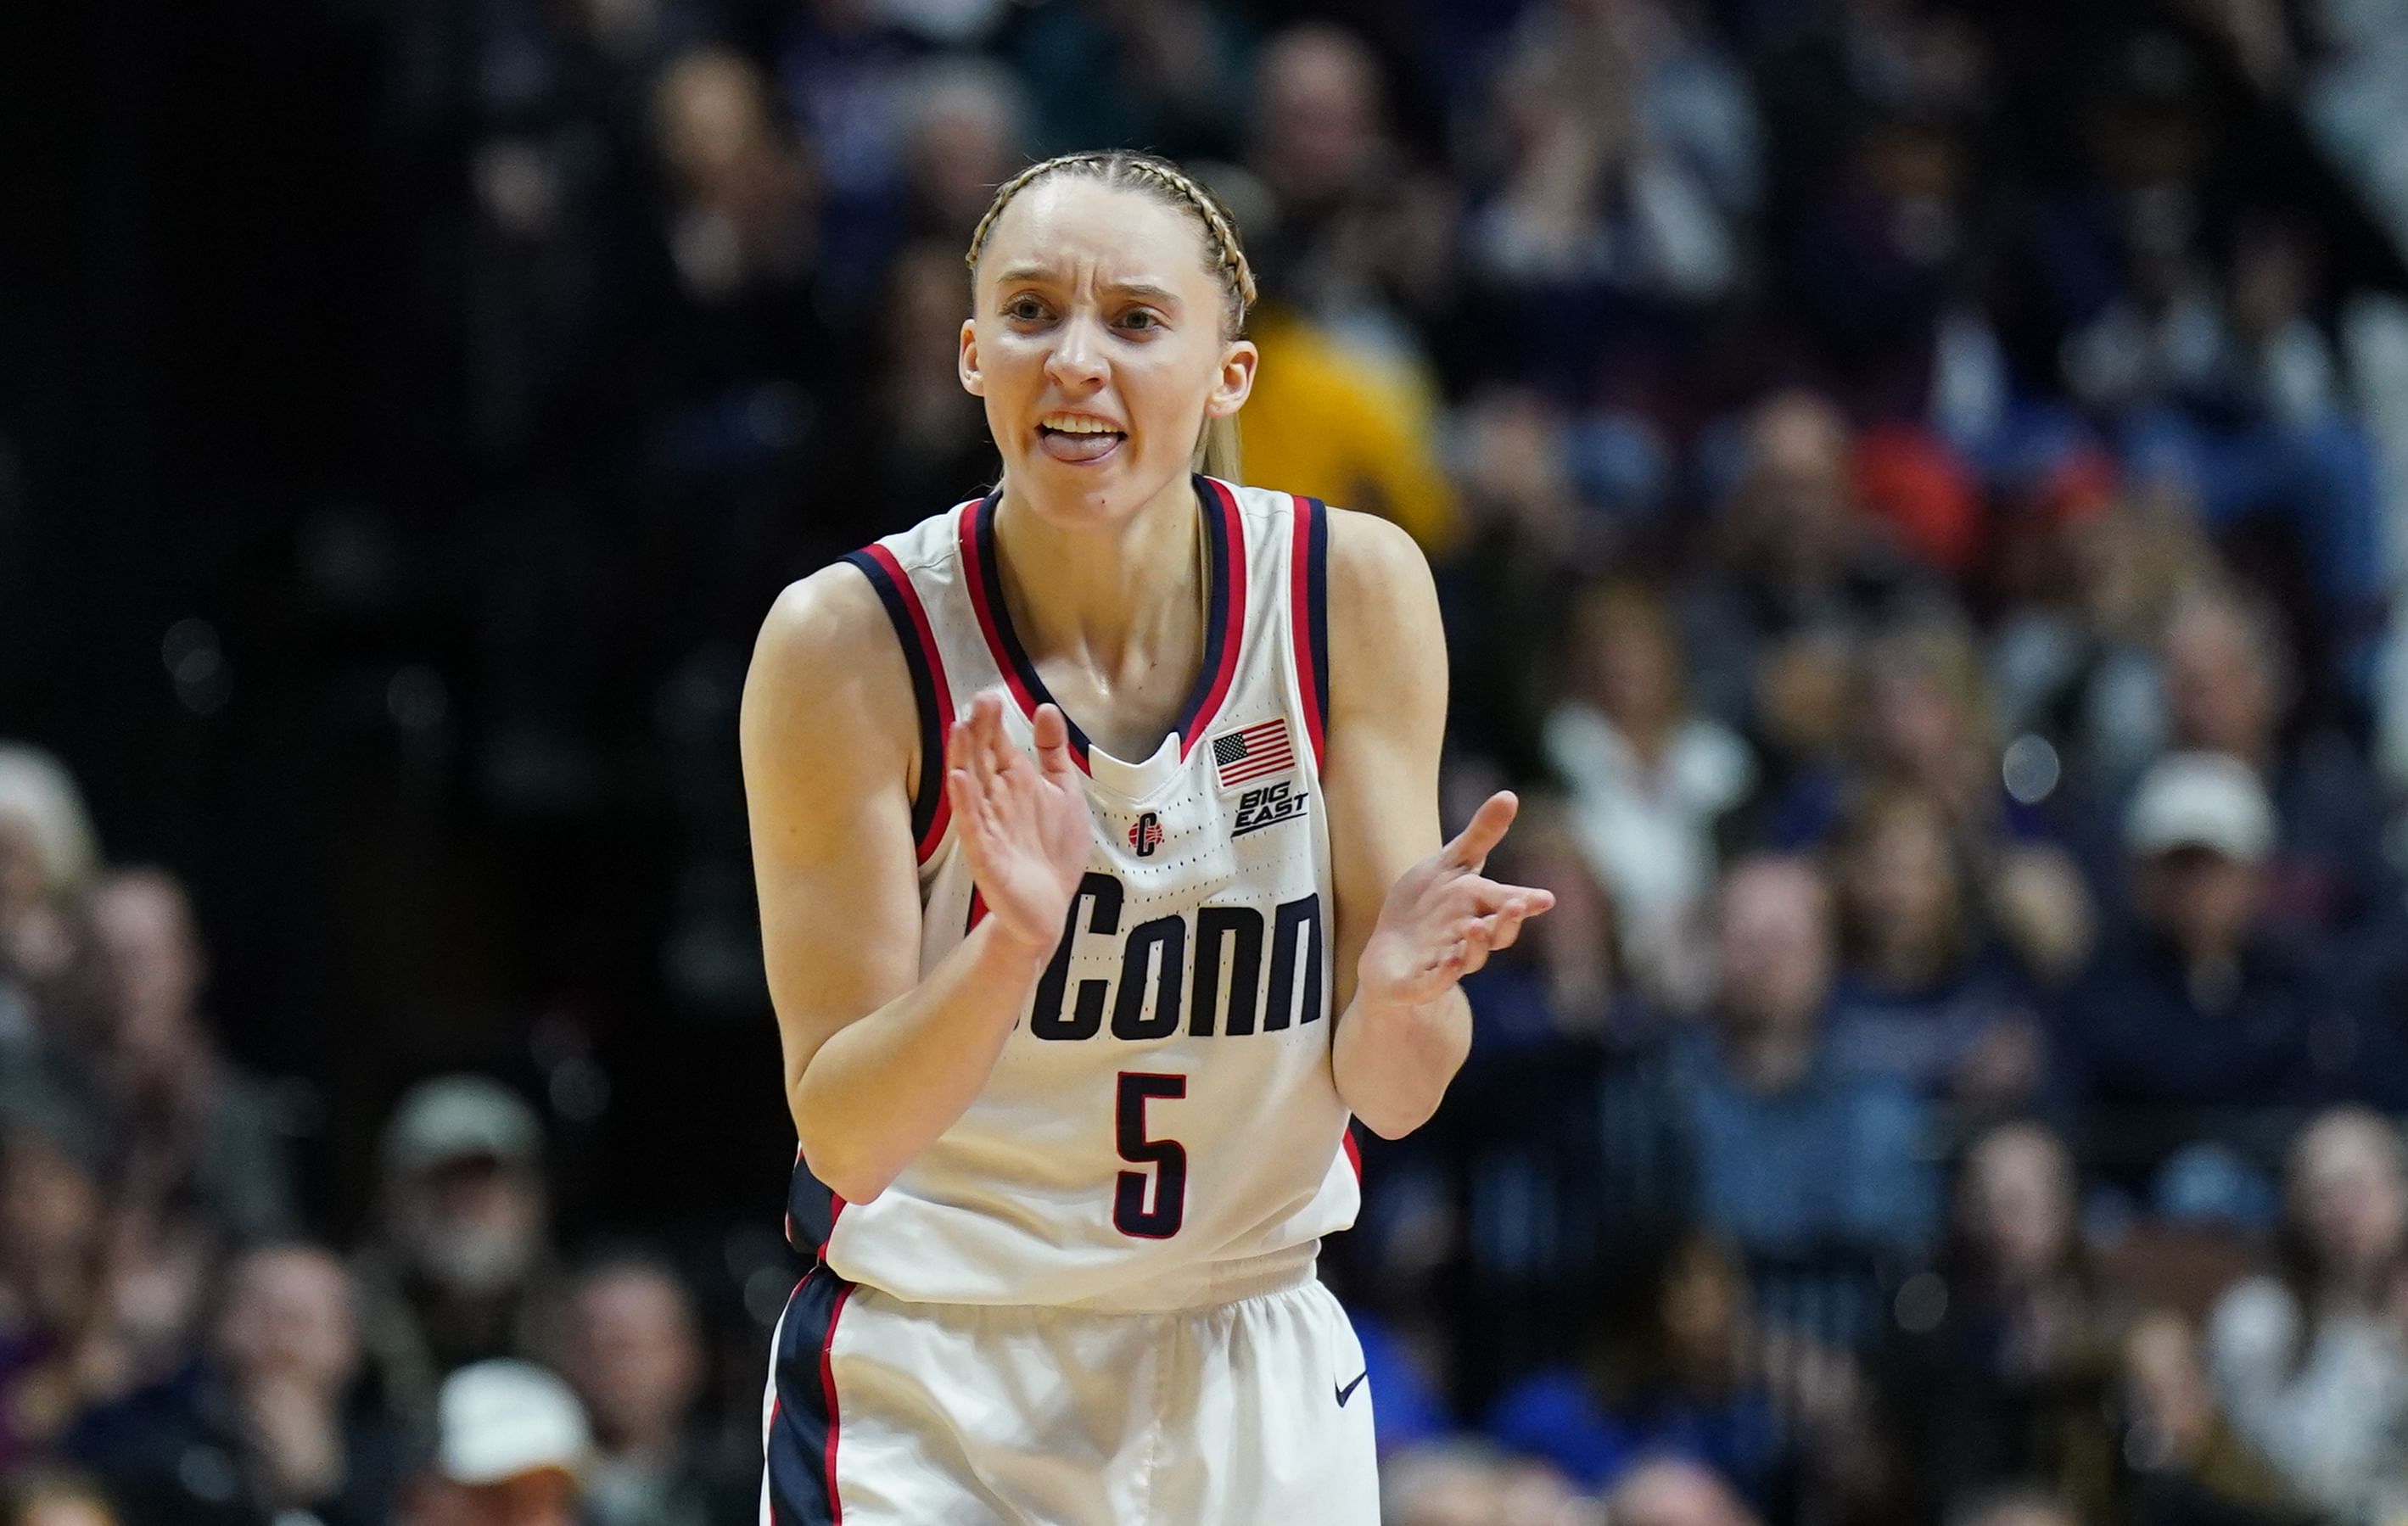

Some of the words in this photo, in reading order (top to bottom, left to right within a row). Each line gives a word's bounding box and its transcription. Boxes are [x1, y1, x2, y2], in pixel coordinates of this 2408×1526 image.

[1235, 793, 1309, 828] EAST
[1240, 781, 1291, 810] BIG
[965, 872, 1322, 1041] Conn
[1113, 1071, 1186, 1238] 5
